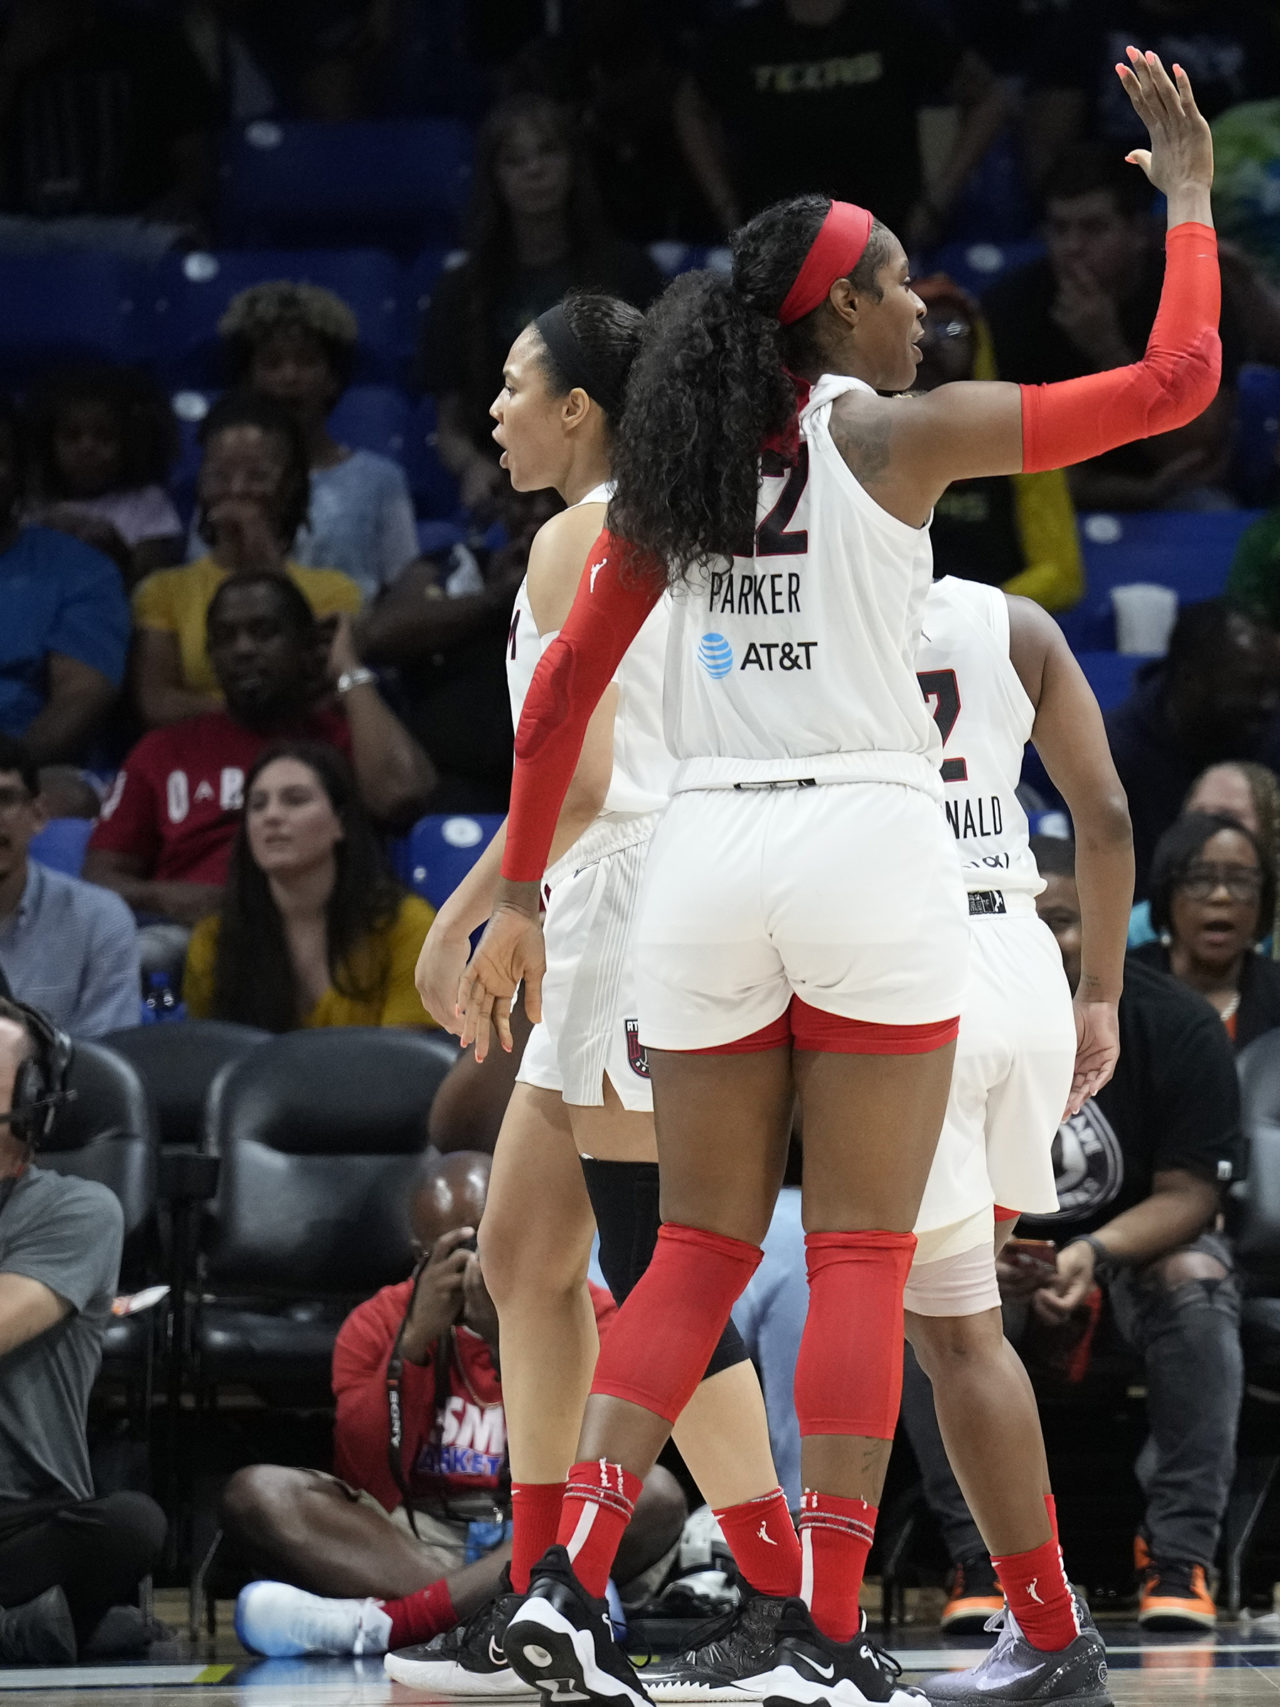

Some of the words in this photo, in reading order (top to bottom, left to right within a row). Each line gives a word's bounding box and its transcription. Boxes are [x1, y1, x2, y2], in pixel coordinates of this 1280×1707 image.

[709, 571, 801, 615] PARKER
[740, 641, 818, 671] AT&T
[917, 669, 968, 783] 2
[388, 1390, 401, 1448] SONY
